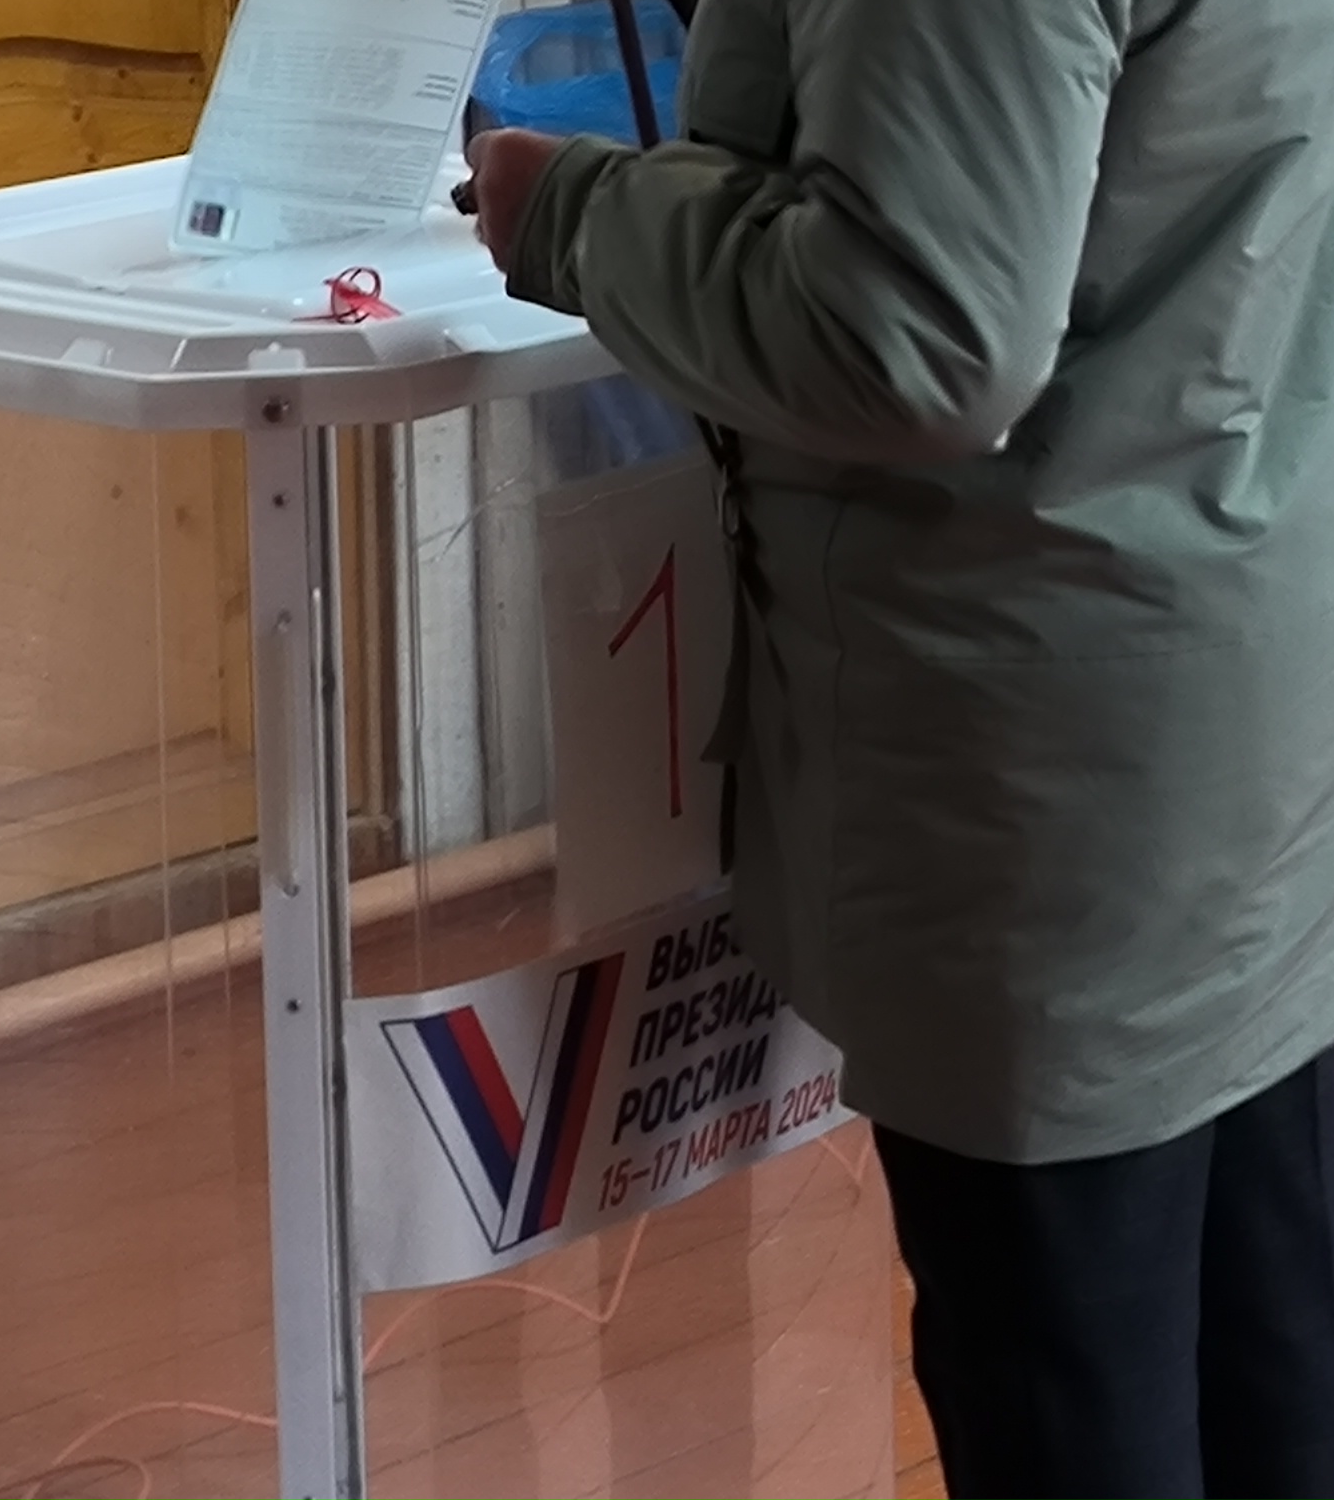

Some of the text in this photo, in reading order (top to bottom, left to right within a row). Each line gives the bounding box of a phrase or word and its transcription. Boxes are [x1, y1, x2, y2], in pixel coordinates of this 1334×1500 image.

[609, 543, 682, 818] 1
[646, 912, 743, 991] ВЫБ
[629, 971, 787, 1068] ПРЕЗИД
[611, 1033, 769, 1146] РОССИИ
[683, 1098, 772, 1178] МАРТА
[777, 1070, 836, 1136] 2024
